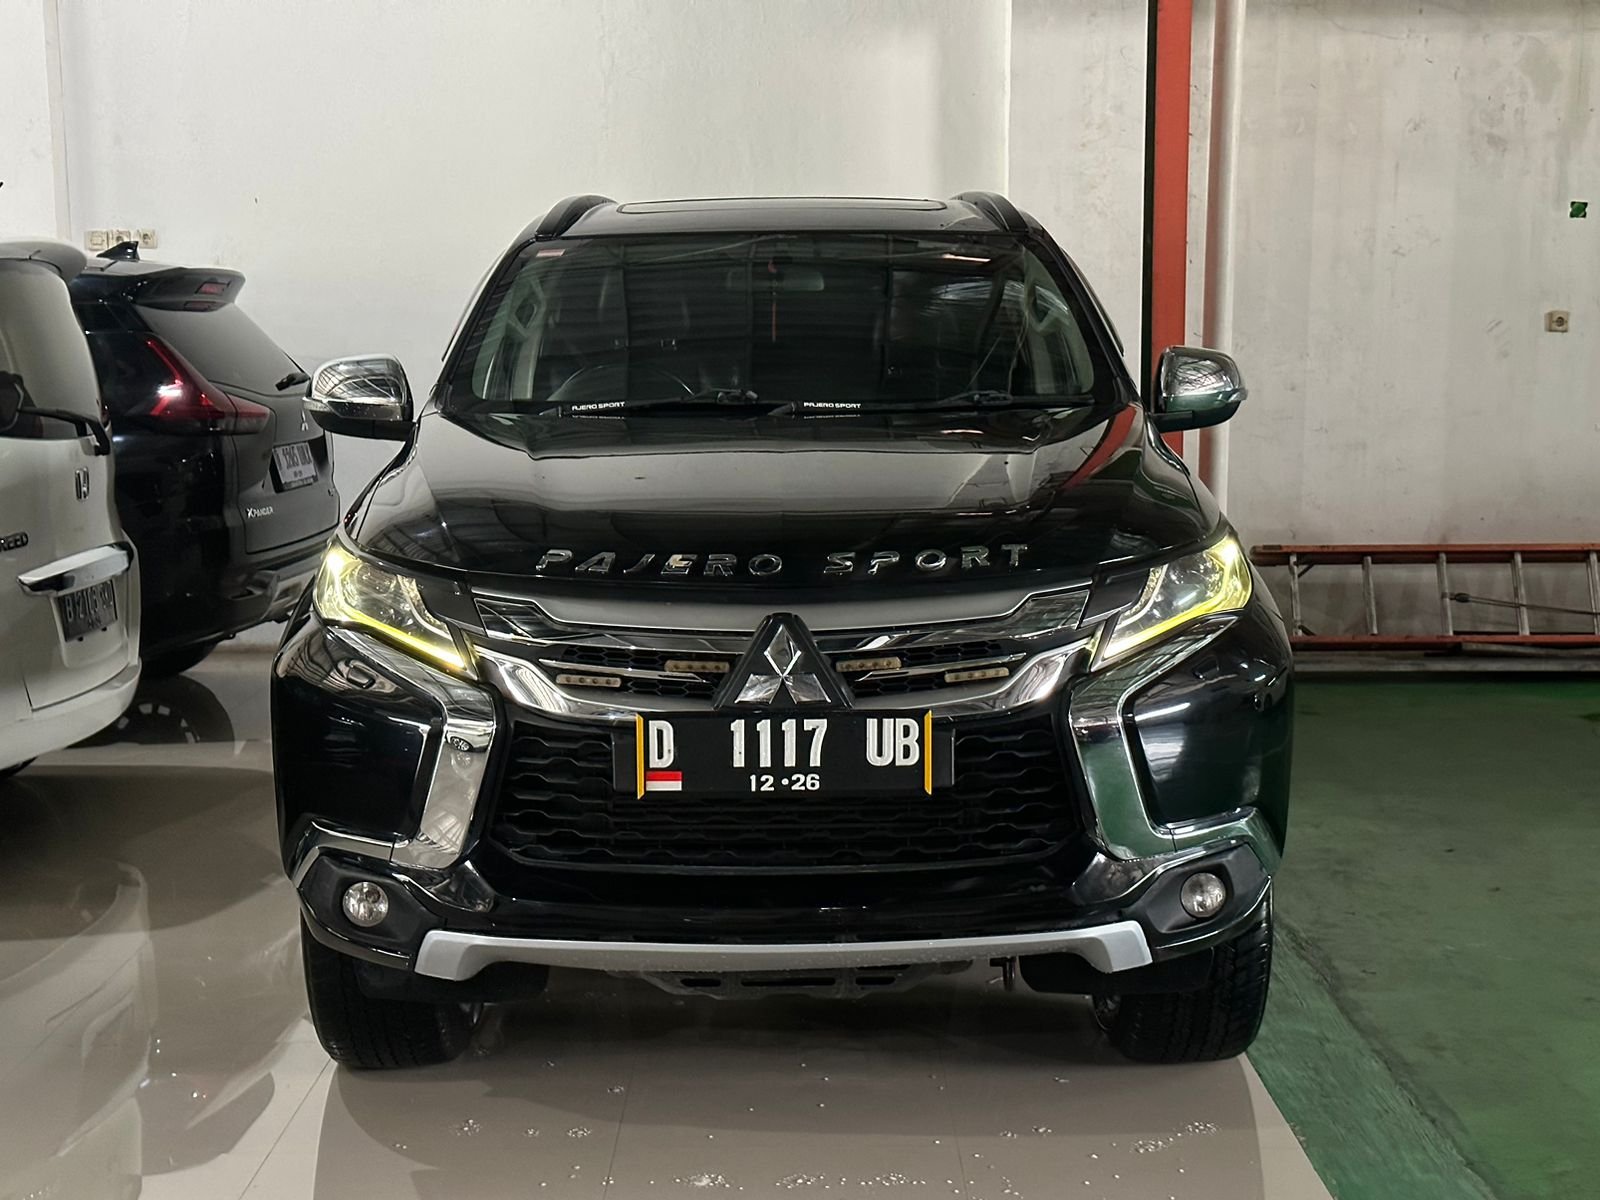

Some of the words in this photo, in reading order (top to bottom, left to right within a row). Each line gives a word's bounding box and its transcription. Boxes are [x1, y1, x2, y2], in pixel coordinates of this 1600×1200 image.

[598, 401, 625, 409] SPORT
[536, 549, 783, 576] PAJERO
[824, 544, 1028, 576] SPORT
[648, 719, 675, 769] D
[730, 718, 828, 768] 1117
[865, 717, 920, 767] UB
